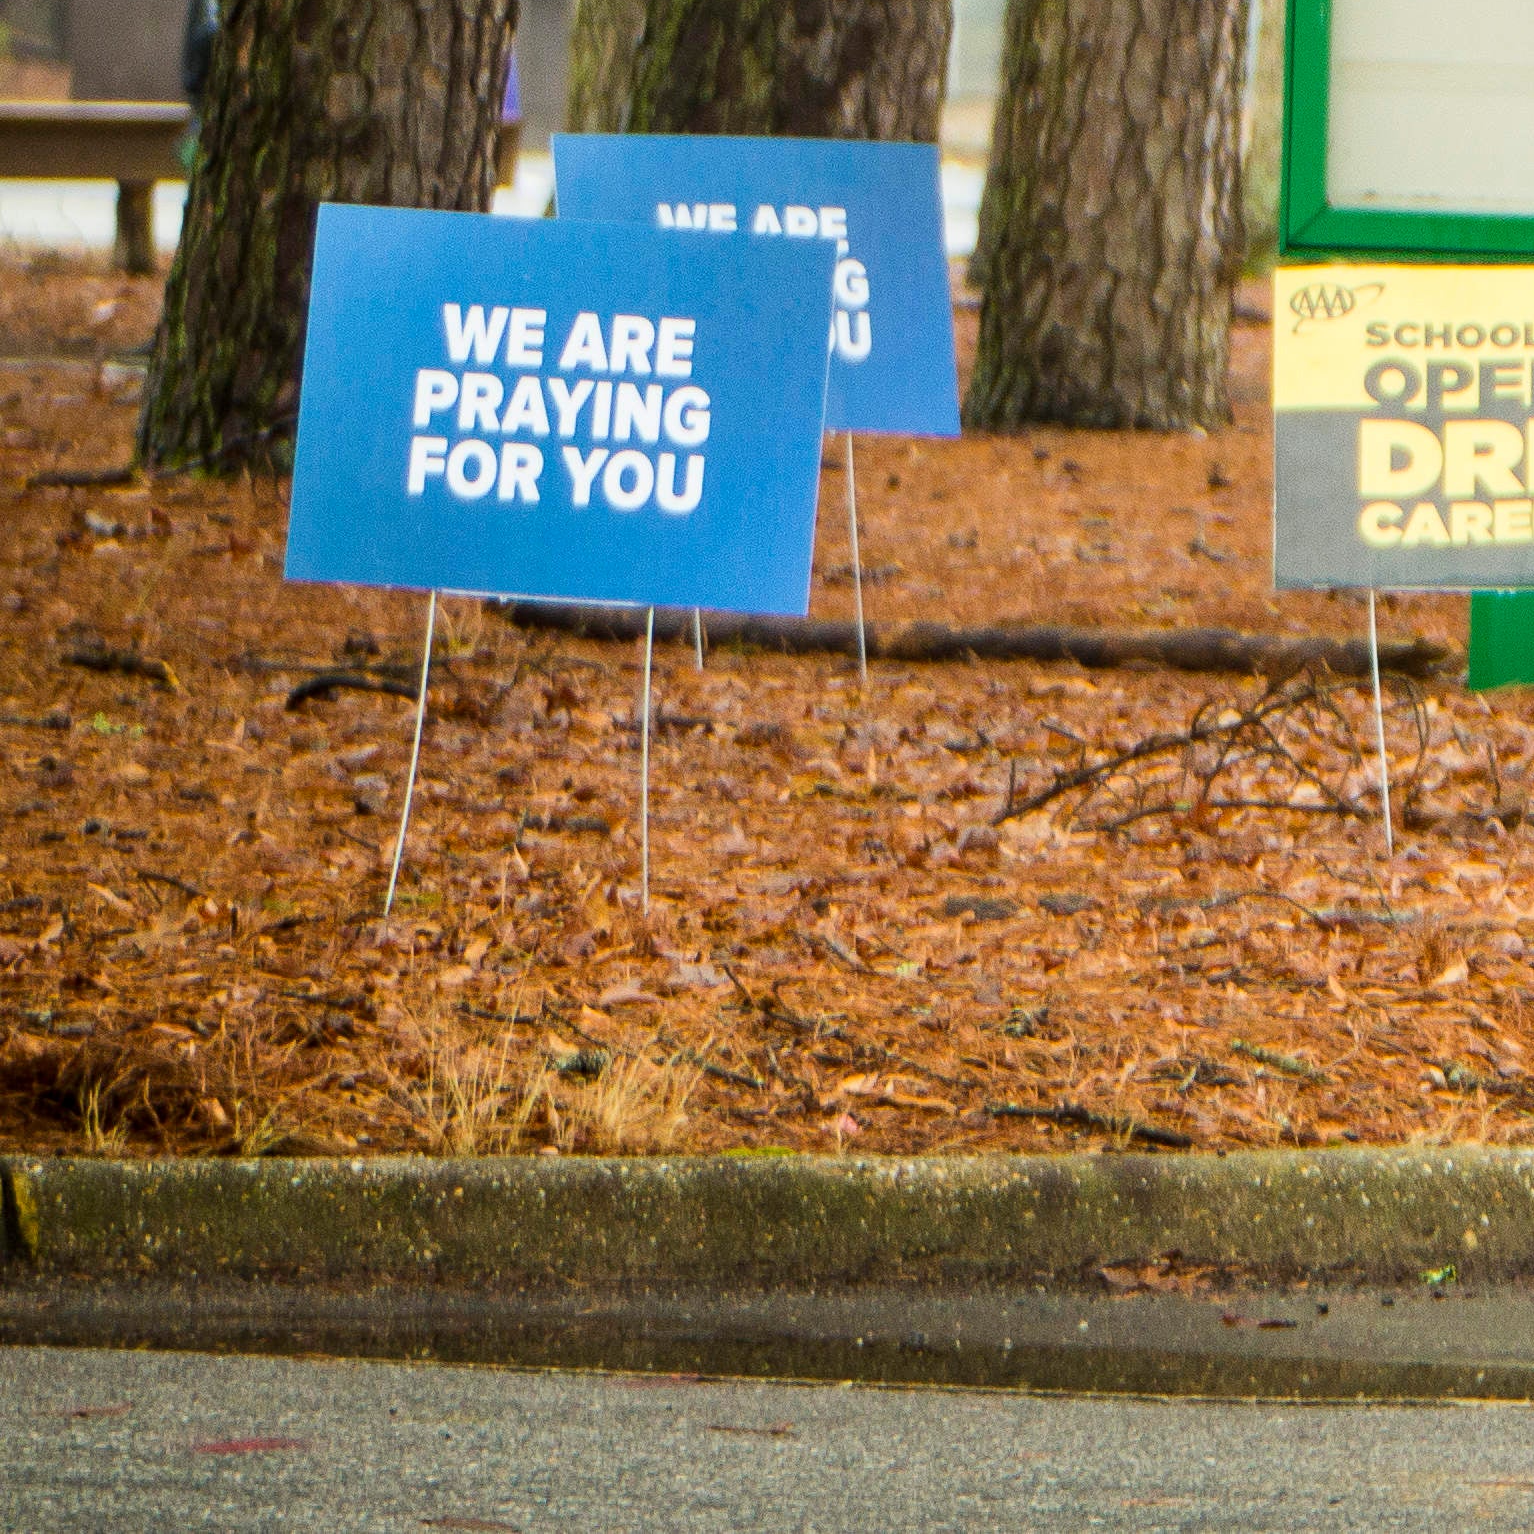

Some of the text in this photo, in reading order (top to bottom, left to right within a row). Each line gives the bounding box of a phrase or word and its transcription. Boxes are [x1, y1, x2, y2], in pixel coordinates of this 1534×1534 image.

[442, 302, 697, 378] WE ARE
[411, 368, 711, 445] PRAYING
[406, 436, 706, 515] FOR YOU
